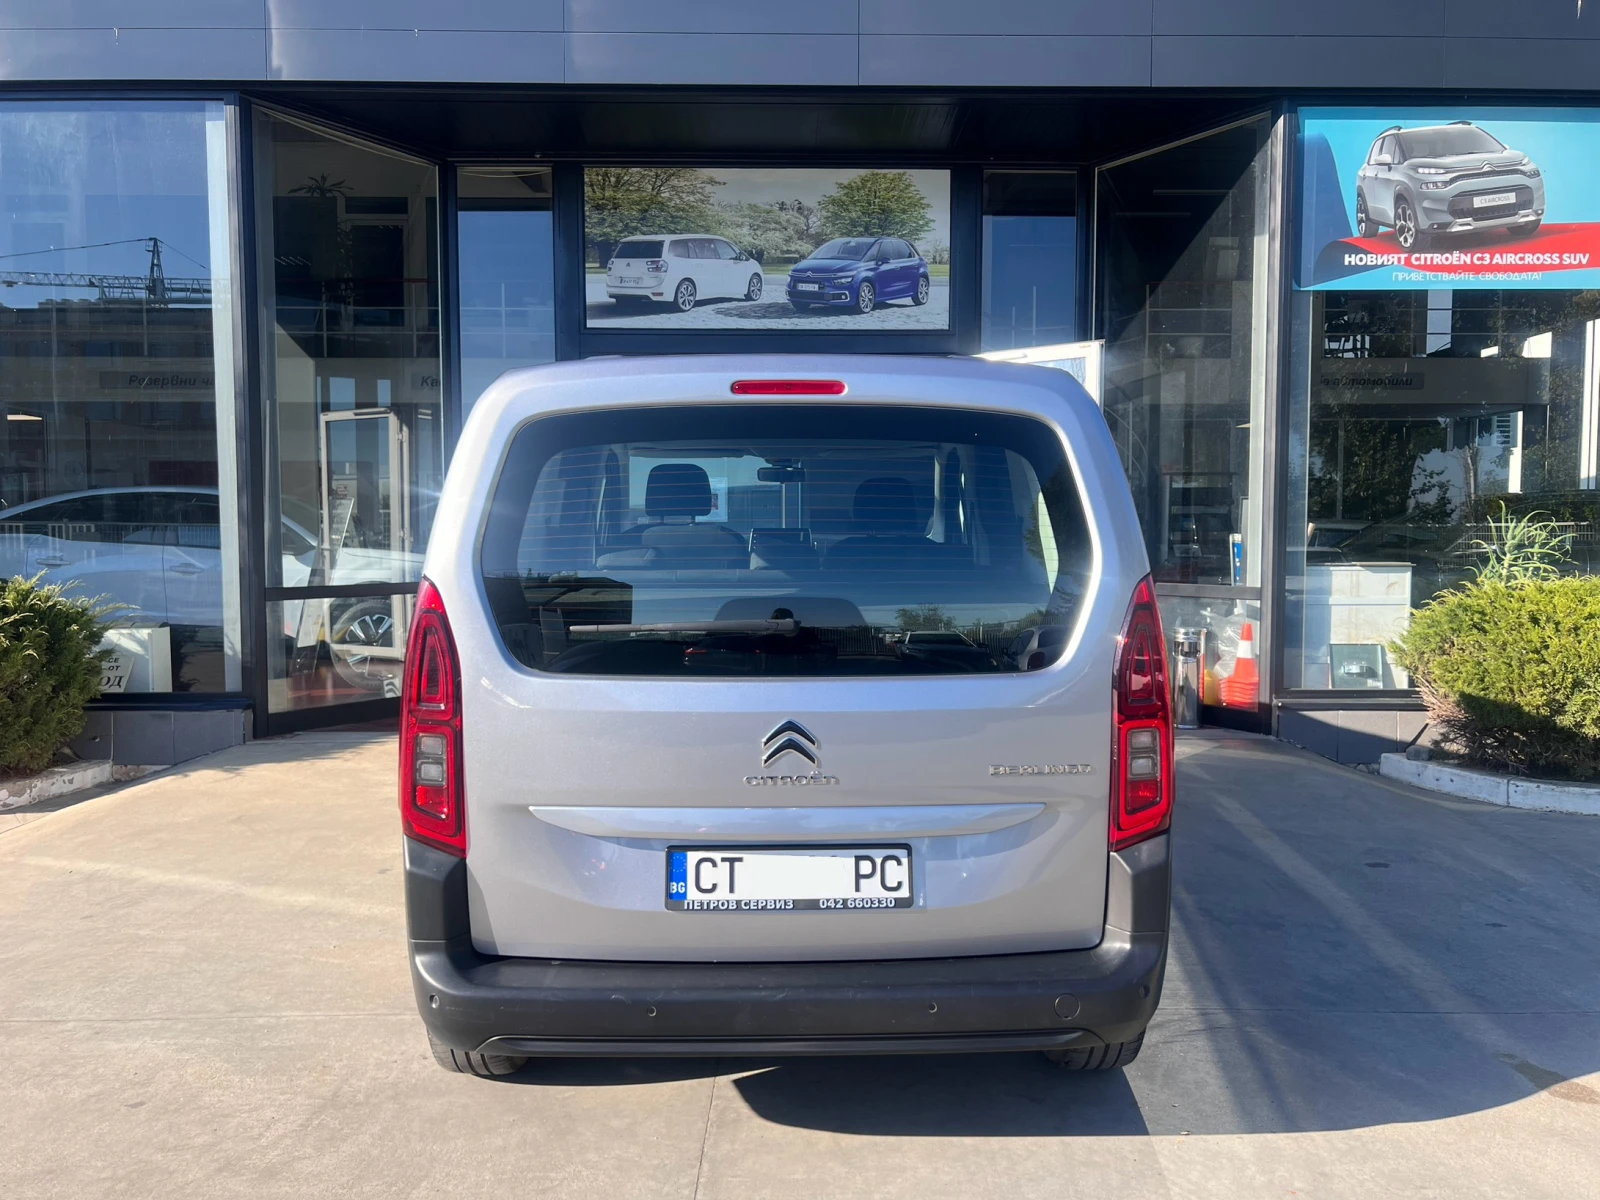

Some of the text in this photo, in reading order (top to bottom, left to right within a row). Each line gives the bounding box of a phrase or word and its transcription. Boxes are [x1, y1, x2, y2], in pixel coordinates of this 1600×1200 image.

[1344, 250, 1590, 266] НОВИЯТ CITROËN C3 AIRCROSS SUV
[1392, 270, 1542, 281] ПРИВЕТСТВАЙТЕ СВОБОДАТА!
[420, 375, 441, 387] Ка
[989, 763, 1092, 776] BERLINGO
[743, 770, 840, 786] CITROËN
[694, 854, 904, 894] CT PC
[669, 881, 686, 894] BG
[684, 897, 896, 910] ПЕТРОВ СЕРВИЗ 042 660330
